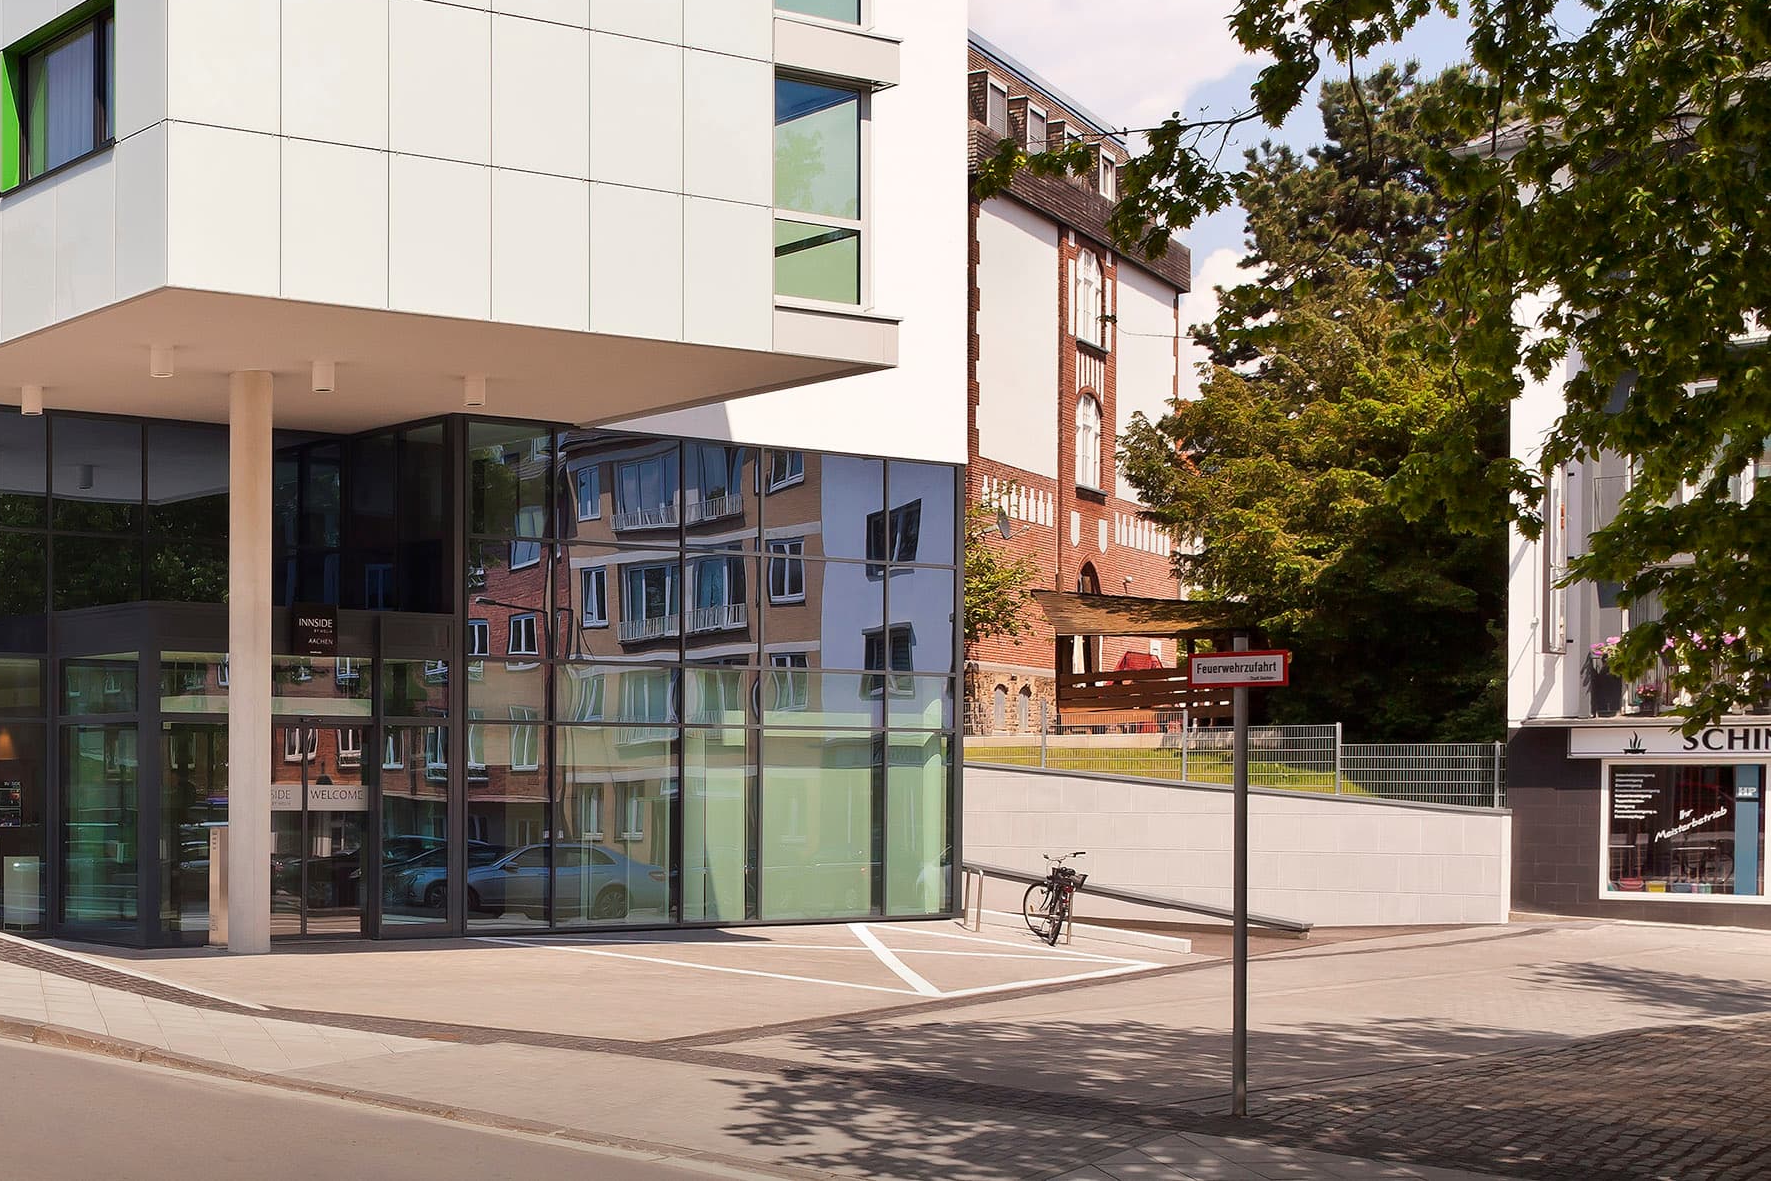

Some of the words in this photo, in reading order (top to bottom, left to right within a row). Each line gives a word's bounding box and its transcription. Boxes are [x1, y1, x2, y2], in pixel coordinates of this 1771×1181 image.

[298, 618, 333, 628] INNSIDE
[1196, 661, 1277, 675] Feuerwehrzufahrt
[310, 789, 364, 800] WELCOME
[1679, 808, 1694, 820] Ihr
[1654, 805, 1728, 843] Meisterbetrieb
